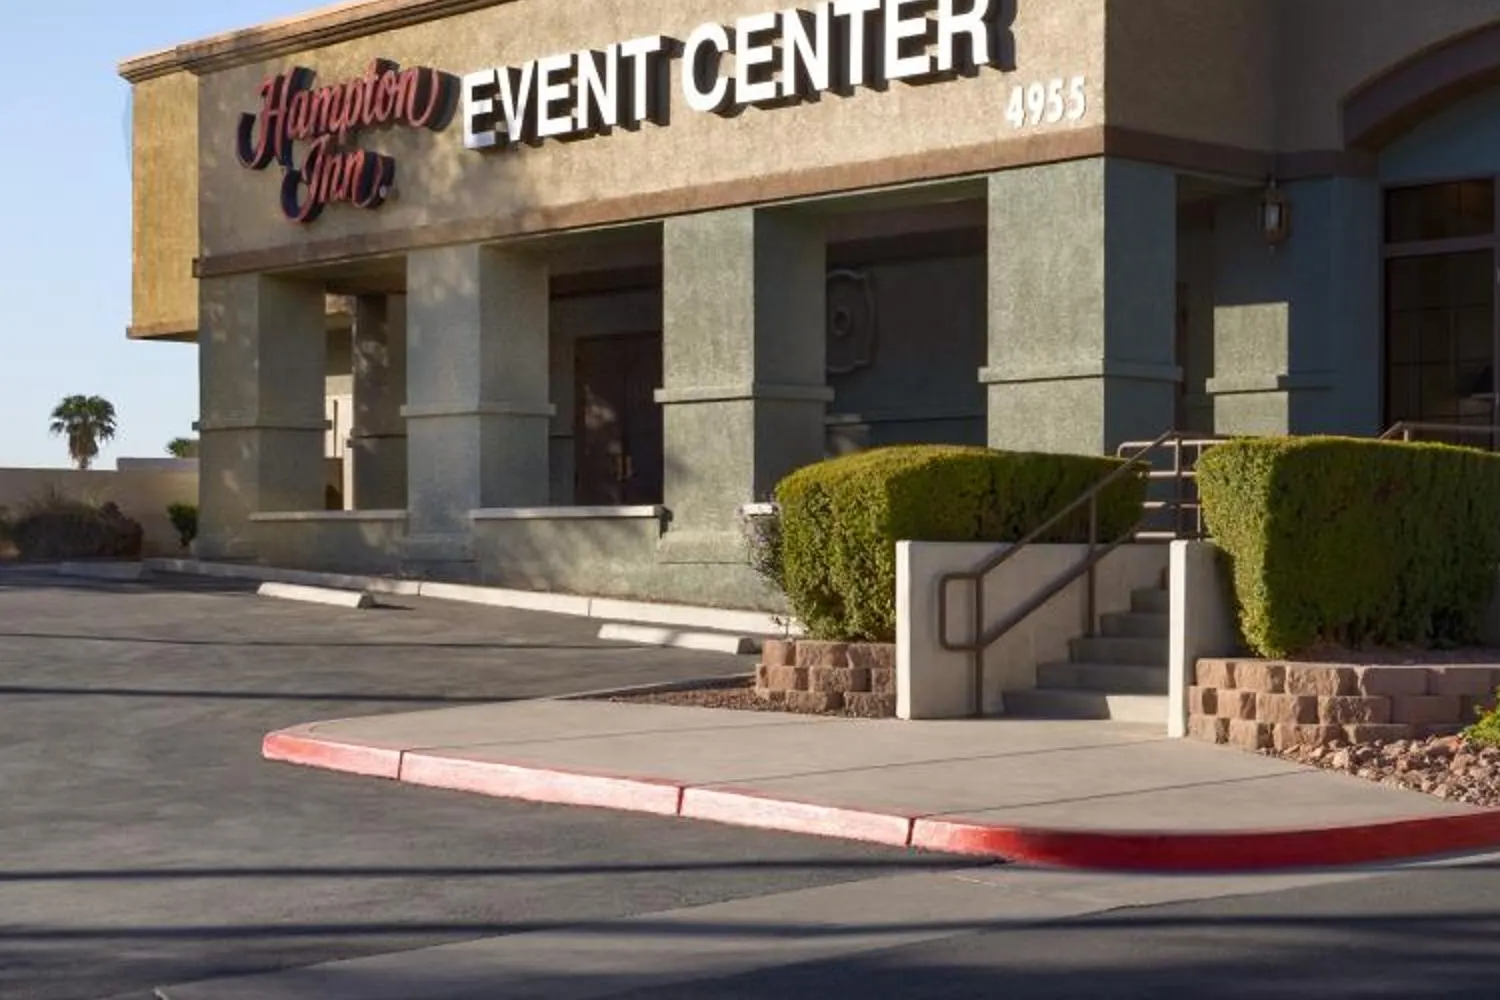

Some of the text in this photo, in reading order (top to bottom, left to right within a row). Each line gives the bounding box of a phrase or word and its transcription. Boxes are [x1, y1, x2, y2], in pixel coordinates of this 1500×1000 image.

[237, 58, 441, 169] Hampton
[463, 34, 662, 148] EVENT
[1005, 76, 1086, 127] 4955
[281, 134, 385, 225] Inn
